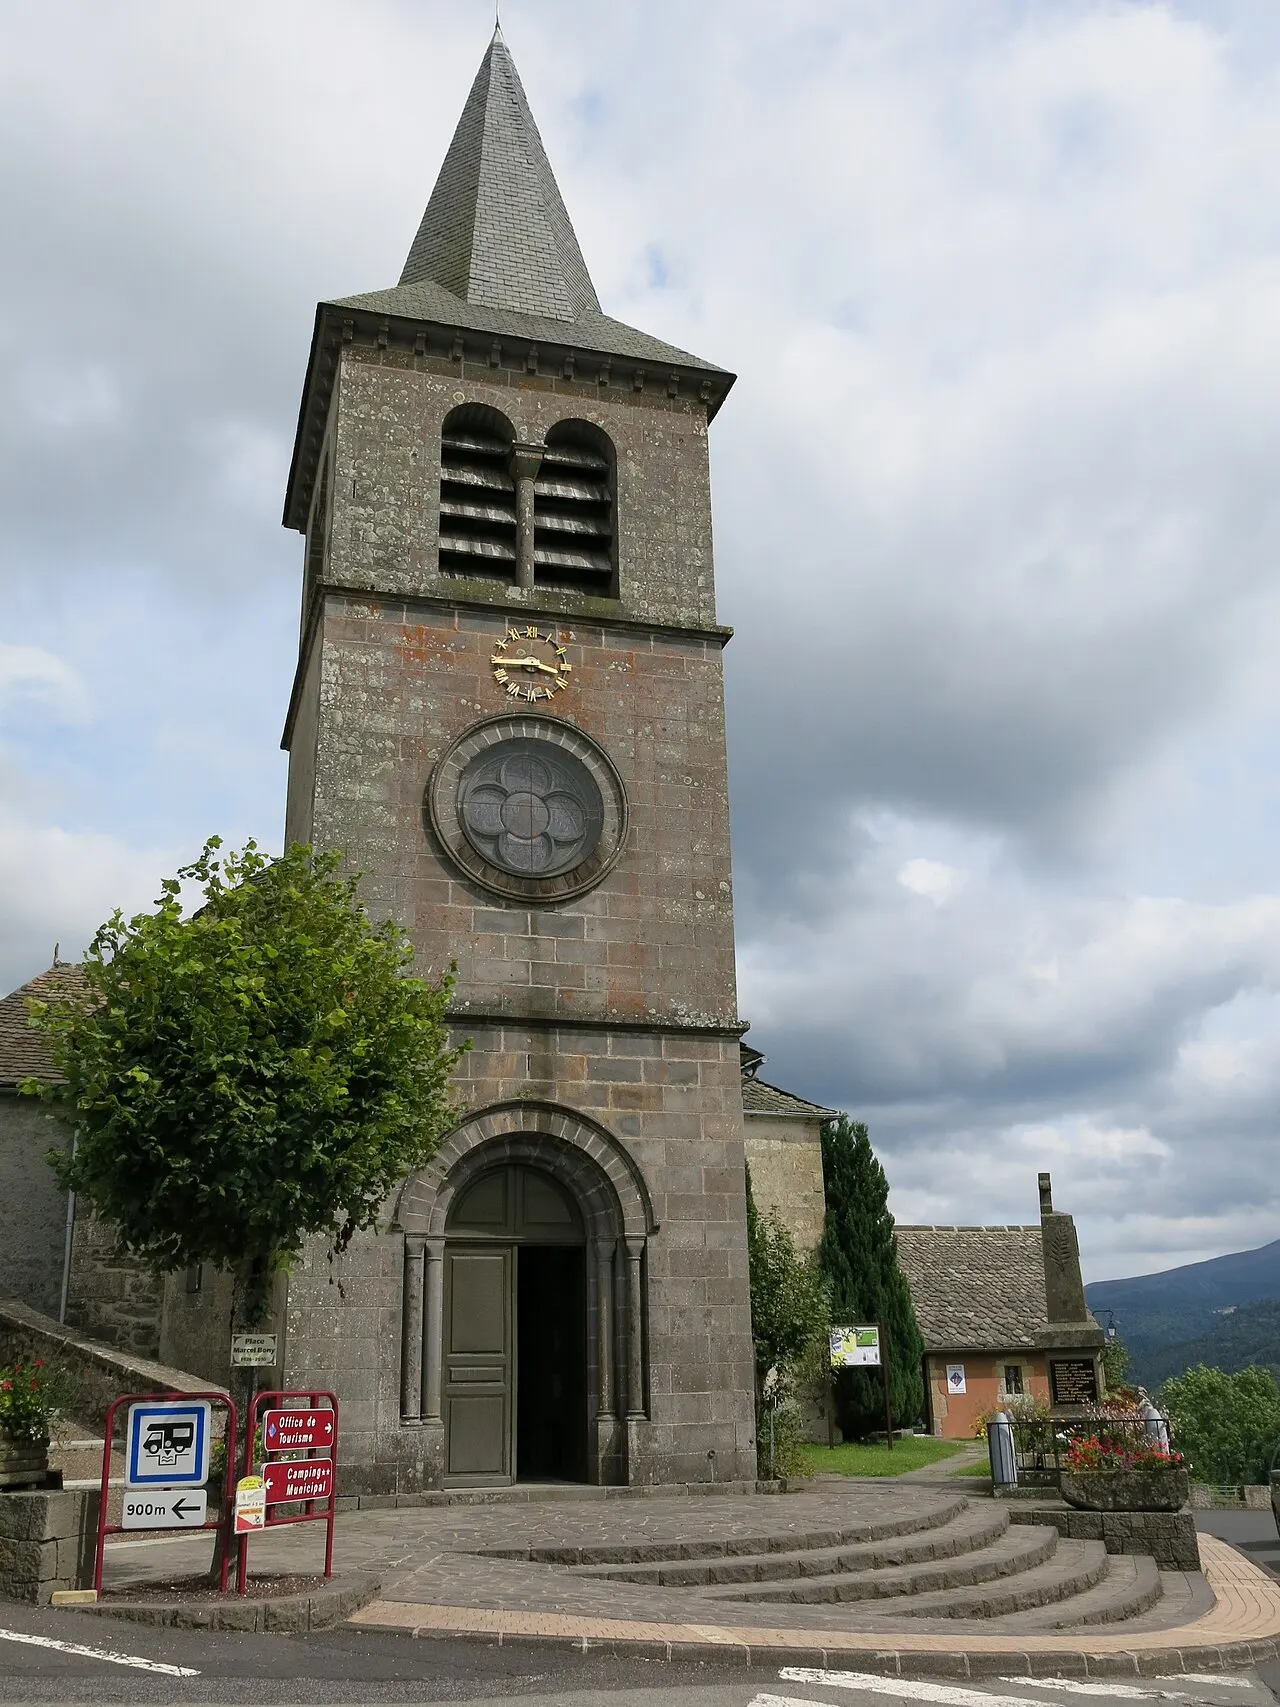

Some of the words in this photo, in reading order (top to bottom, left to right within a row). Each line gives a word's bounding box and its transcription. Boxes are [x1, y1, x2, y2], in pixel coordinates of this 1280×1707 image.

[257, 1347, 276, 1355] Bony
[279, 1416, 303, 1428] Office
[307, 1415, 316, 1427] de
[279, 1432, 313, 1444] Tourisme
[286, 1480, 326, 1496] Municipal
[127, 1503, 166, 1516] 900m
